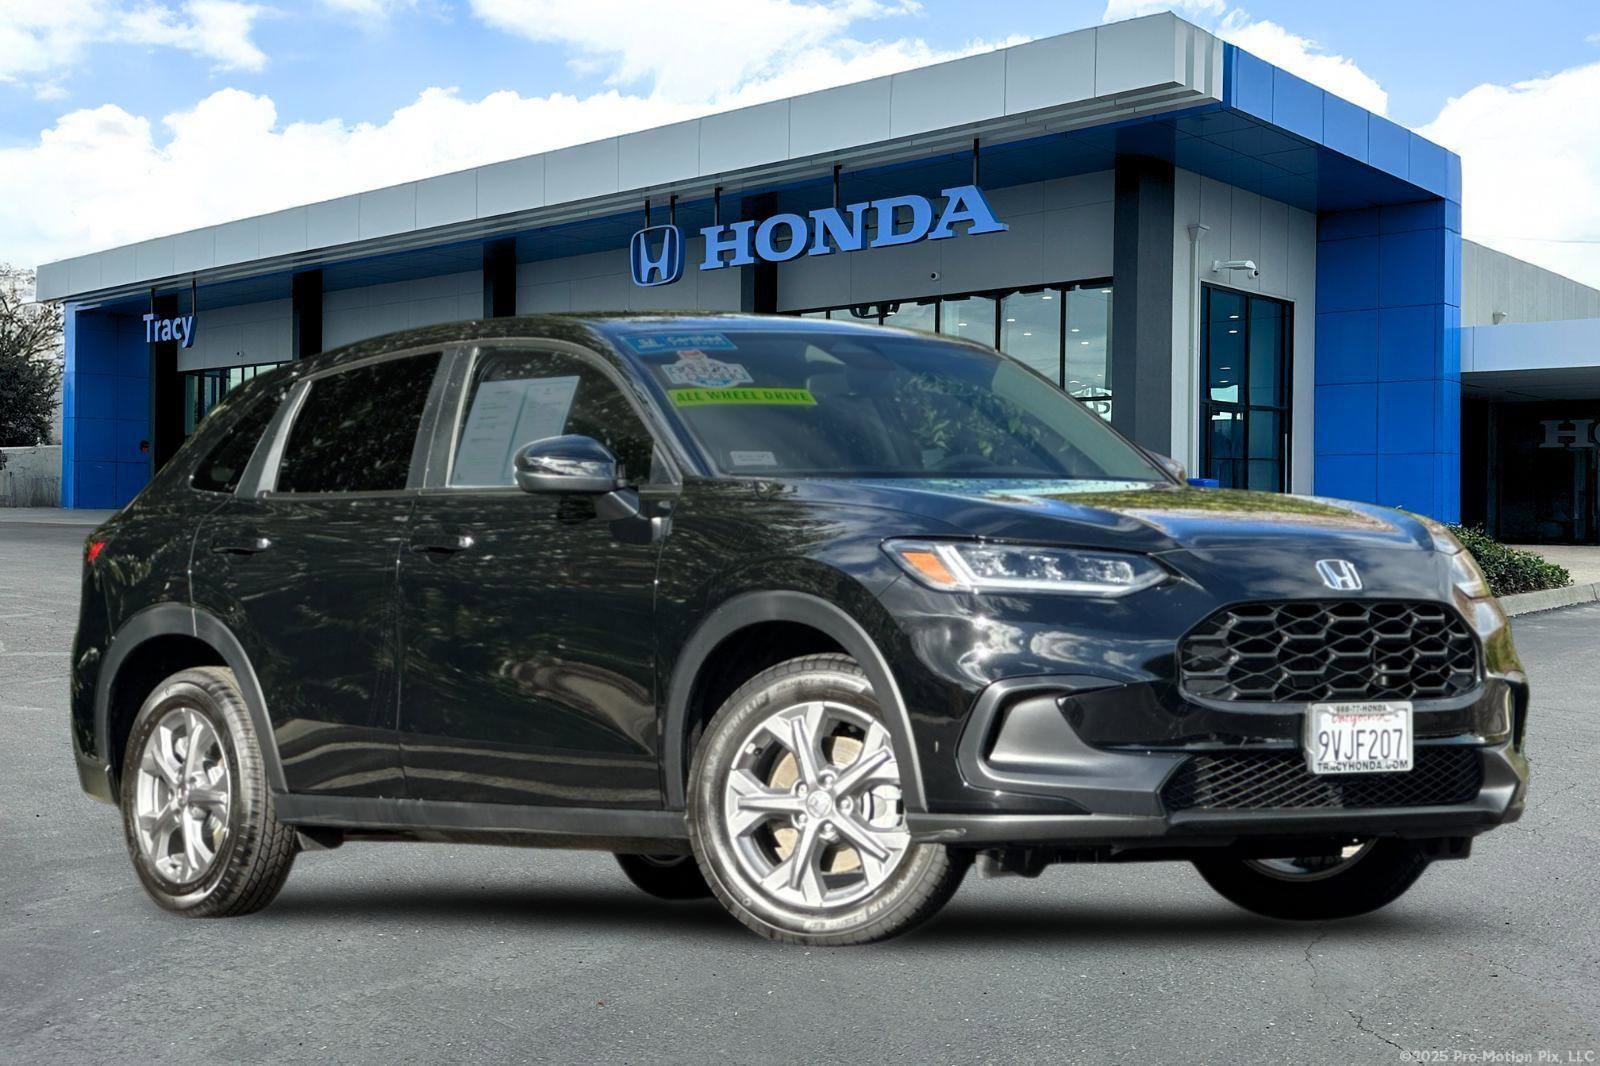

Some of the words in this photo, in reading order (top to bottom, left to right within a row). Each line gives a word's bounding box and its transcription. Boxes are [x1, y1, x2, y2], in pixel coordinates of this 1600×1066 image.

[700, 185, 1009, 271] HONDA
[143, 313, 194, 349] Tracy
[676, 392, 704, 402] ALL
[706, 391, 761, 401] WHEEL
[763, 391, 811, 401] DRIVE
[1318, 728, 1404, 761] 9VJF207
[1317, 760, 1409, 772] TRACYHONDA.COM
